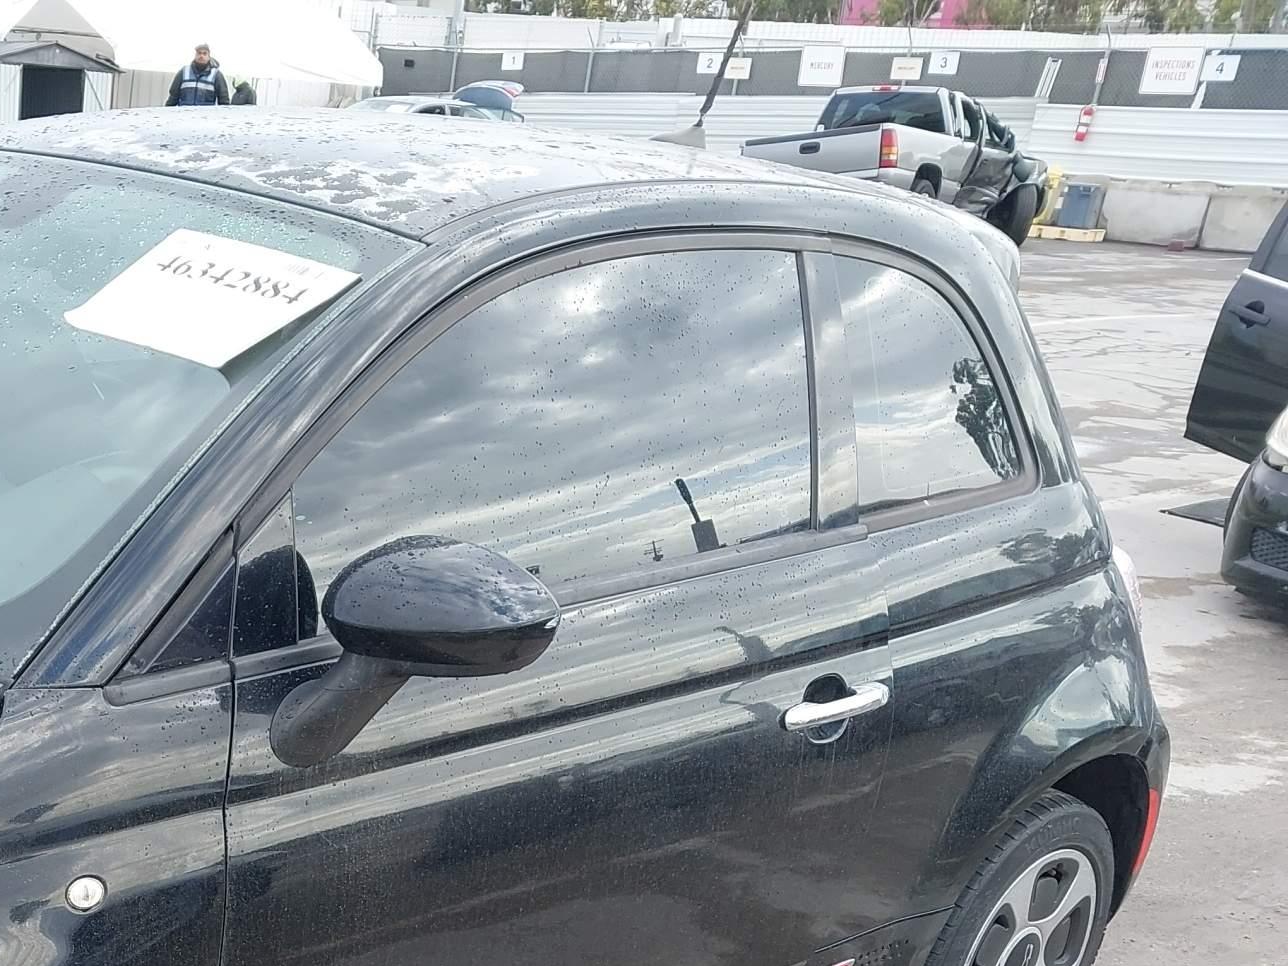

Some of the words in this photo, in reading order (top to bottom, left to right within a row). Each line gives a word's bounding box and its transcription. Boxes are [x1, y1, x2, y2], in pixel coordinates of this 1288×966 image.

[706, 57, 714, 69] 2
[940, 57, 948, 69] 3
[1215, 62, 1225, 75] 4
[157, 255, 310, 305] 46342884
